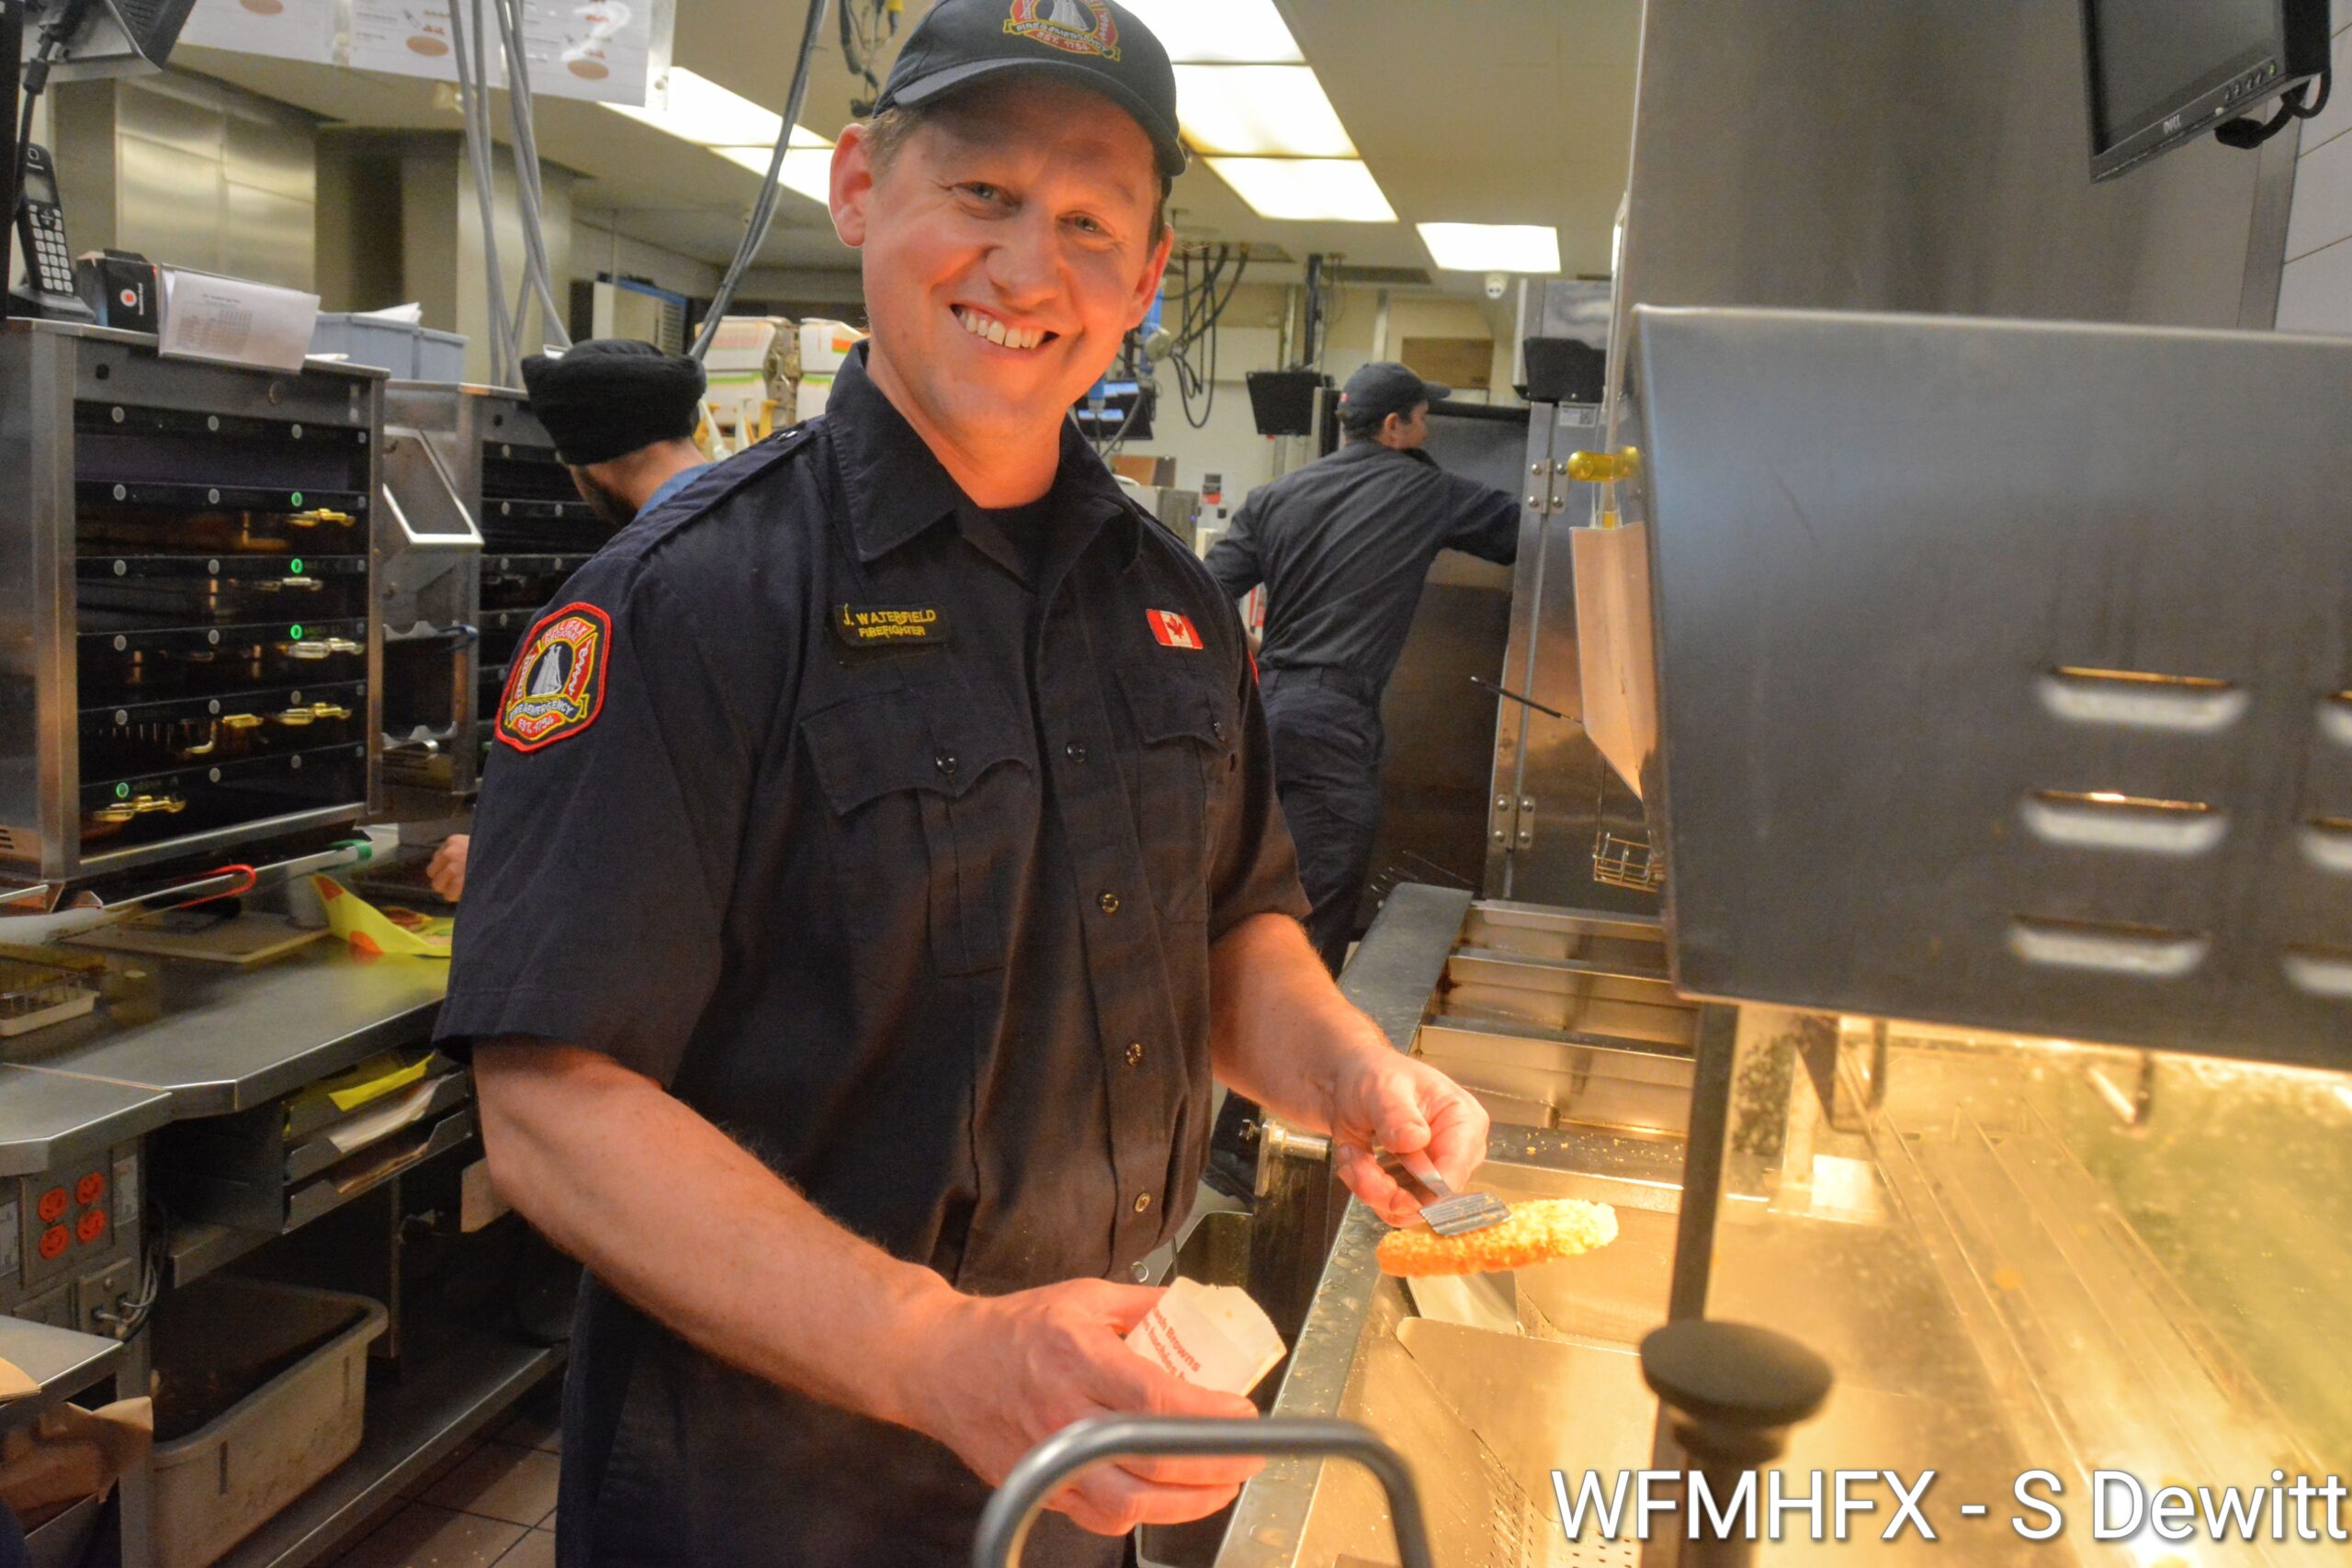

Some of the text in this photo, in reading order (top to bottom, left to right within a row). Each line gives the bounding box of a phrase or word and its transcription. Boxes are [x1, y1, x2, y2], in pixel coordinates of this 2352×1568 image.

[855, 609, 937, 626] WATERFIELD
[858, 625, 926, 638] FIREFIGHTER
[1166, 1325, 1202, 1372] Browns
